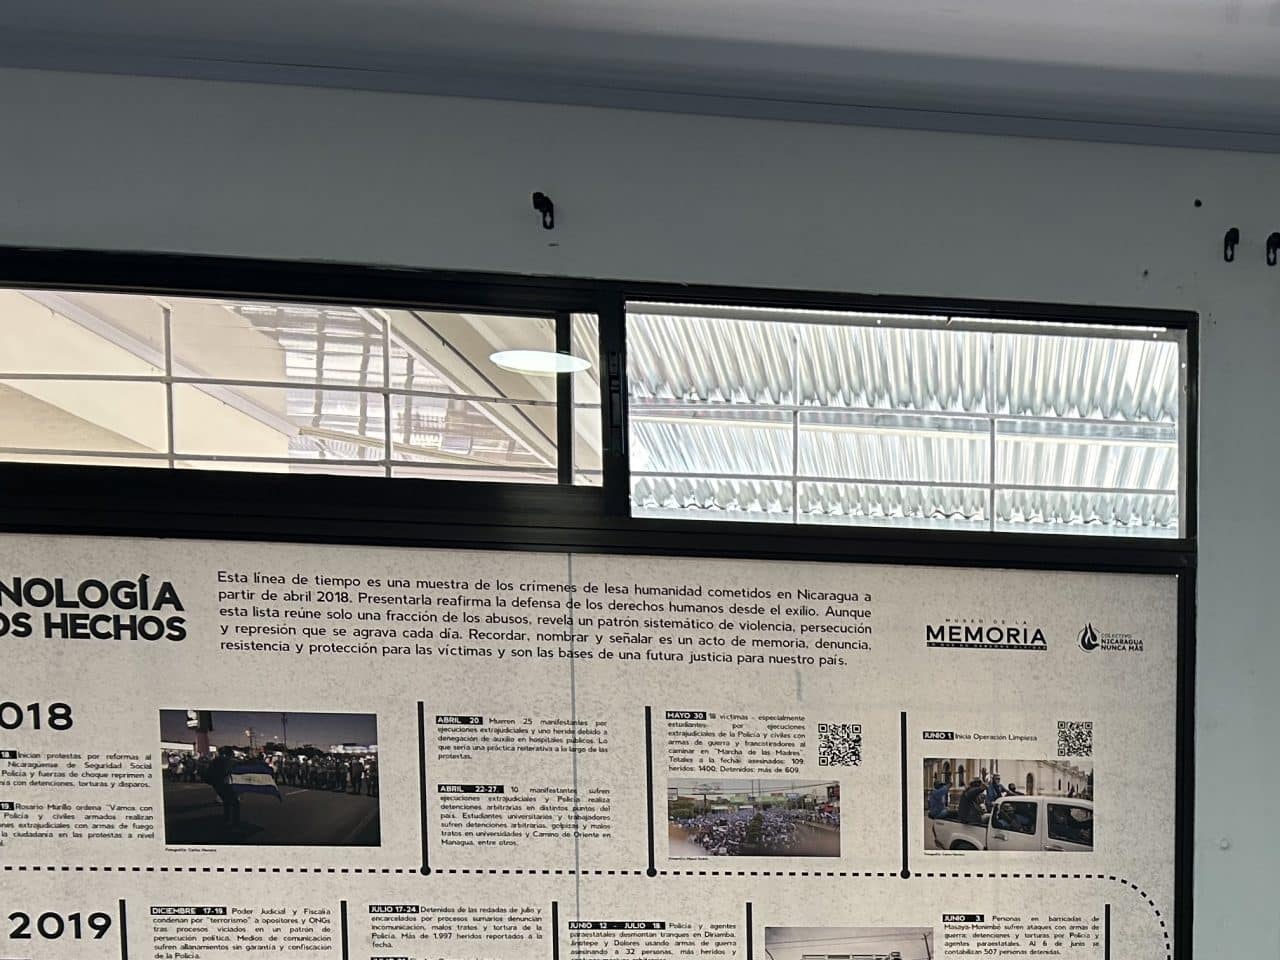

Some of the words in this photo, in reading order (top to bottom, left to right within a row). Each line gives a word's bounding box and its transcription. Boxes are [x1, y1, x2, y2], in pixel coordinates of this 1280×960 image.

[217, 571, 248, 583] Esta
[253, 571, 285, 584] línea
[291, 573, 308, 585] de
[315, 575, 361, 589] tiempo
[367, 579, 381, 587] es
[387, 579, 410, 588] una
[416, 579, 469, 590] muestra
[474, 579, 491, 590] de
[496, 579, 514, 591] los
[519, 580, 577, 593] crímenes
[583, 582, 599, 593] de
[604, 583, 629, 594] lesa
[634, 584, 702, 596] humanidad
[707, 587, 771, 599] cometidos
[777, 591, 792, 599] en
[797, 589, 859, 603] Nicaragua
[864, 593, 871, 602] a
[218, 589, 256, 602] partir
[261, 589, 278, 601] de
[283, 590, 311, 602] abril
[317, 591, 352, 603] 2018.
[358, 592, 432, 605] Presentarla
[437, 595, 491, 607] reafirma
[496, 596, 506, 607] la
[511, 596, 561, 608] defensa
[565, 598, 581, 609] de
[586, 598, 603, 610] los
[608, 599, 664, 612] derechos
[669, 601, 724, 614] humanos
[729, 603, 765, 615] desde
[770, 604, 781, 615] el
[785, 605, 819, 616] exilio.
[825, 606, 871, 620] Aunque
[44, 613, 187, 641] HECHOS
[219, 607, 248, 617] esta
[253, 606, 280, 618] lista
[284, 607, 322, 619] reúne
[327, 608, 353, 620] solo
[357, 612, 381, 621] una
[386, 609, 437, 622] fracción
[442, 611, 458, 623] de
[463, 611, 480, 623] los
[537, 614, 573, 626] revela
[578, 618, 593, 626] un
[598, 616, 639, 629] patrón
[644, 618, 714, 629] sistemático
[718, 619, 734, 630] de
[800, 622, 872, 635] persecución
[220, 625, 229, 635] y
[235, 623, 296, 637] represión
[302, 627, 326, 638] que
[333, 628, 347, 636] se
[353, 628, 397, 640] agrava
[402, 627, 433, 639] cada
[439, 628, 462, 639] día.
[536, 631, 589, 642] nombrar
[595, 635, 603, 645] y
[609, 632, 653, 644] señalar
[659, 636, 672, 645] es
[678, 637, 693, 645] un
[698, 636, 725, 646] acto
[731, 635, 746, 646] de
[926, 625, 1047, 645] MEMORIA
[221, 640, 290, 651] resistencia
[295, 644, 304, 654] y
[309, 642, 377, 655] protección
[382, 646, 411, 657] para
[415, 643, 432, 655] las
[438, 644, 492, 656] víctimas
[498, 649, 506, 659] y
[511, 649, 532, 657] son
[537, 646, 554, 658] las
[558, 647, 593, 659] bases
[598, 648, 614, 659] de
[619, 652, 641, 660] una
[646, 649, 683, 661] futura
[689, 651, 732, 664] justicia
[737, 655, 764, 665] para
[769, 655, 814, 664] nuestro
[819, 654, 847, 668] país.
[0, 702, 73, 730] 018
[8, 912, 112, 940] 2019
